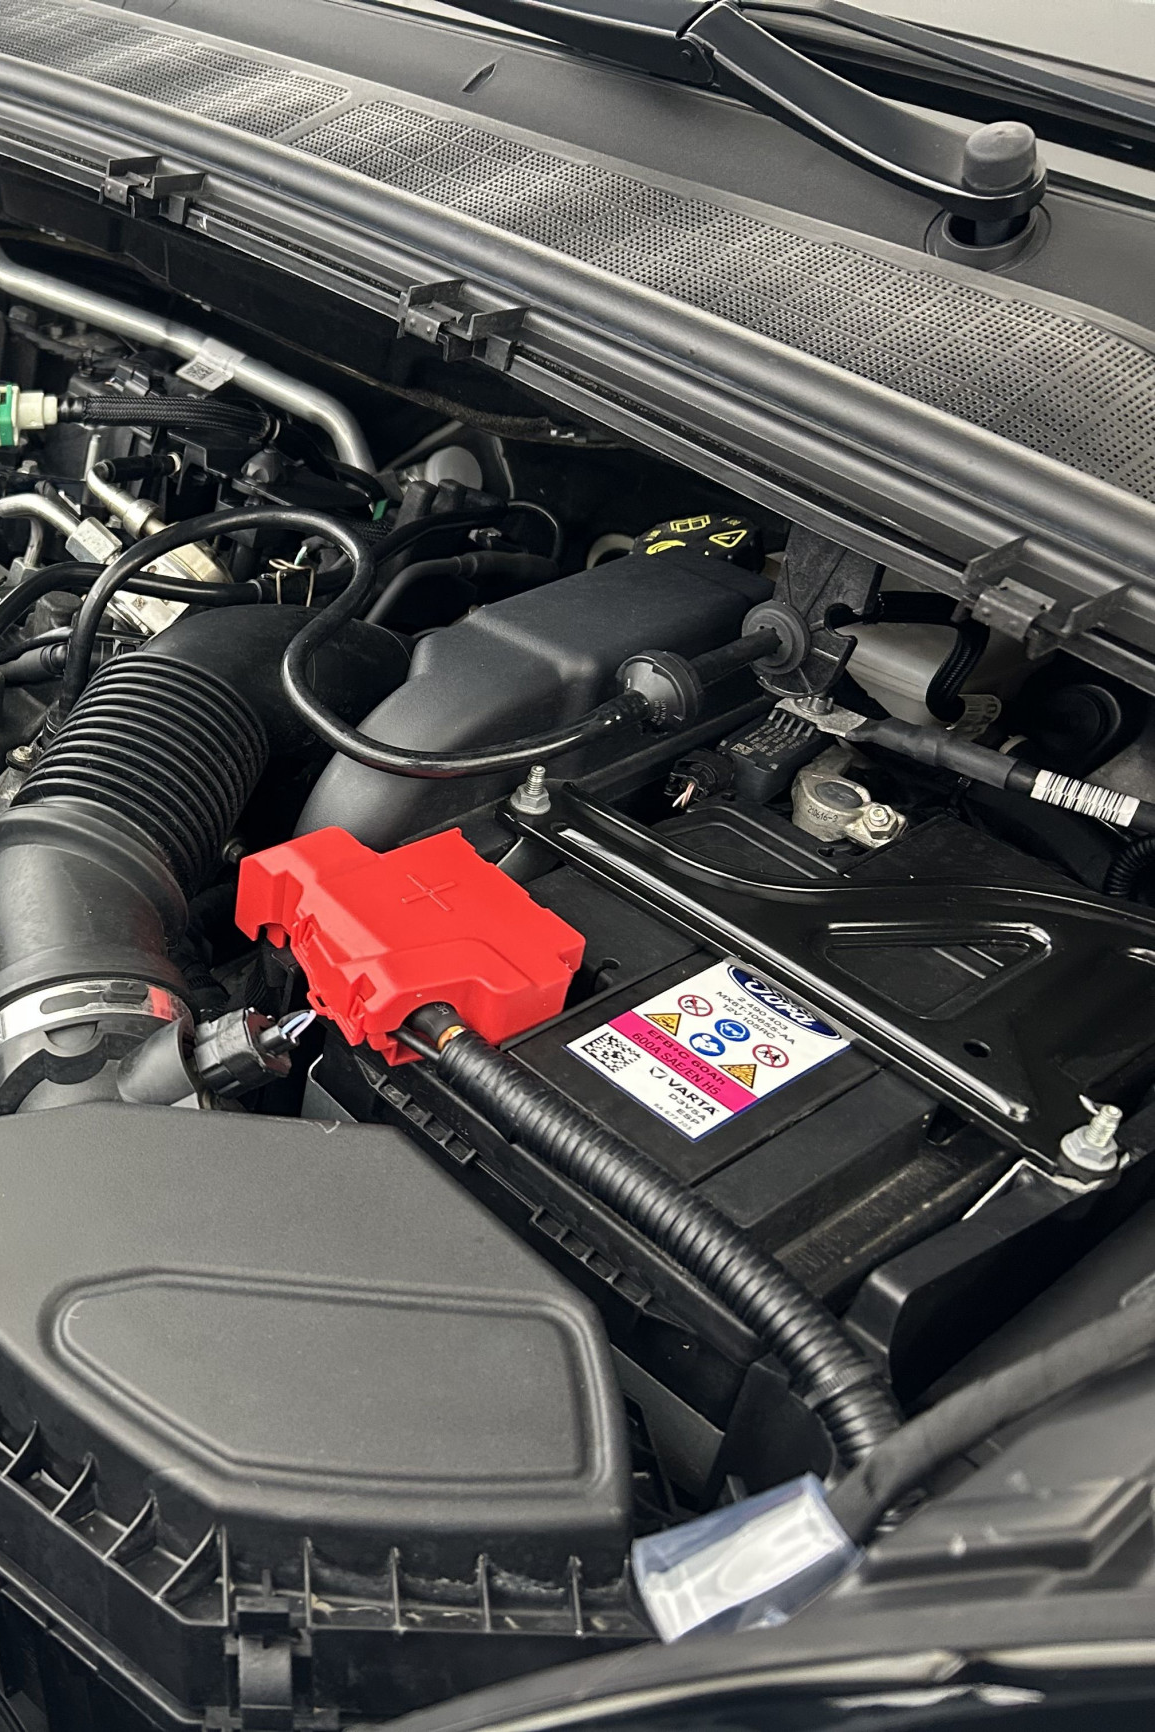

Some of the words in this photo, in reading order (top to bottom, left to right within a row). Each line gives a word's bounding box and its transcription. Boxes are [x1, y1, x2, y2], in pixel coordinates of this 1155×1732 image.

[722, 1003, 743, 1016] 12V
[742, 1017, 776, 1039] 105RC
[744, 977, 818, 1027] Ford
[747, 1003, 767, 1017] 490
[767, 1016, 789, 1031] 403
[632, 1033, 661, 1054] 600A
[661, 1052, 704, 1083] SAE/EN
[702, 1081, 722, 1095] H5
[647, 1029, 690, 1060] EFB+C
[691, 1060, 726, 1085] 60Ah
[668, 1078, 716, 1116] VARTA
[676, 1108, 700, 1124] ESP
